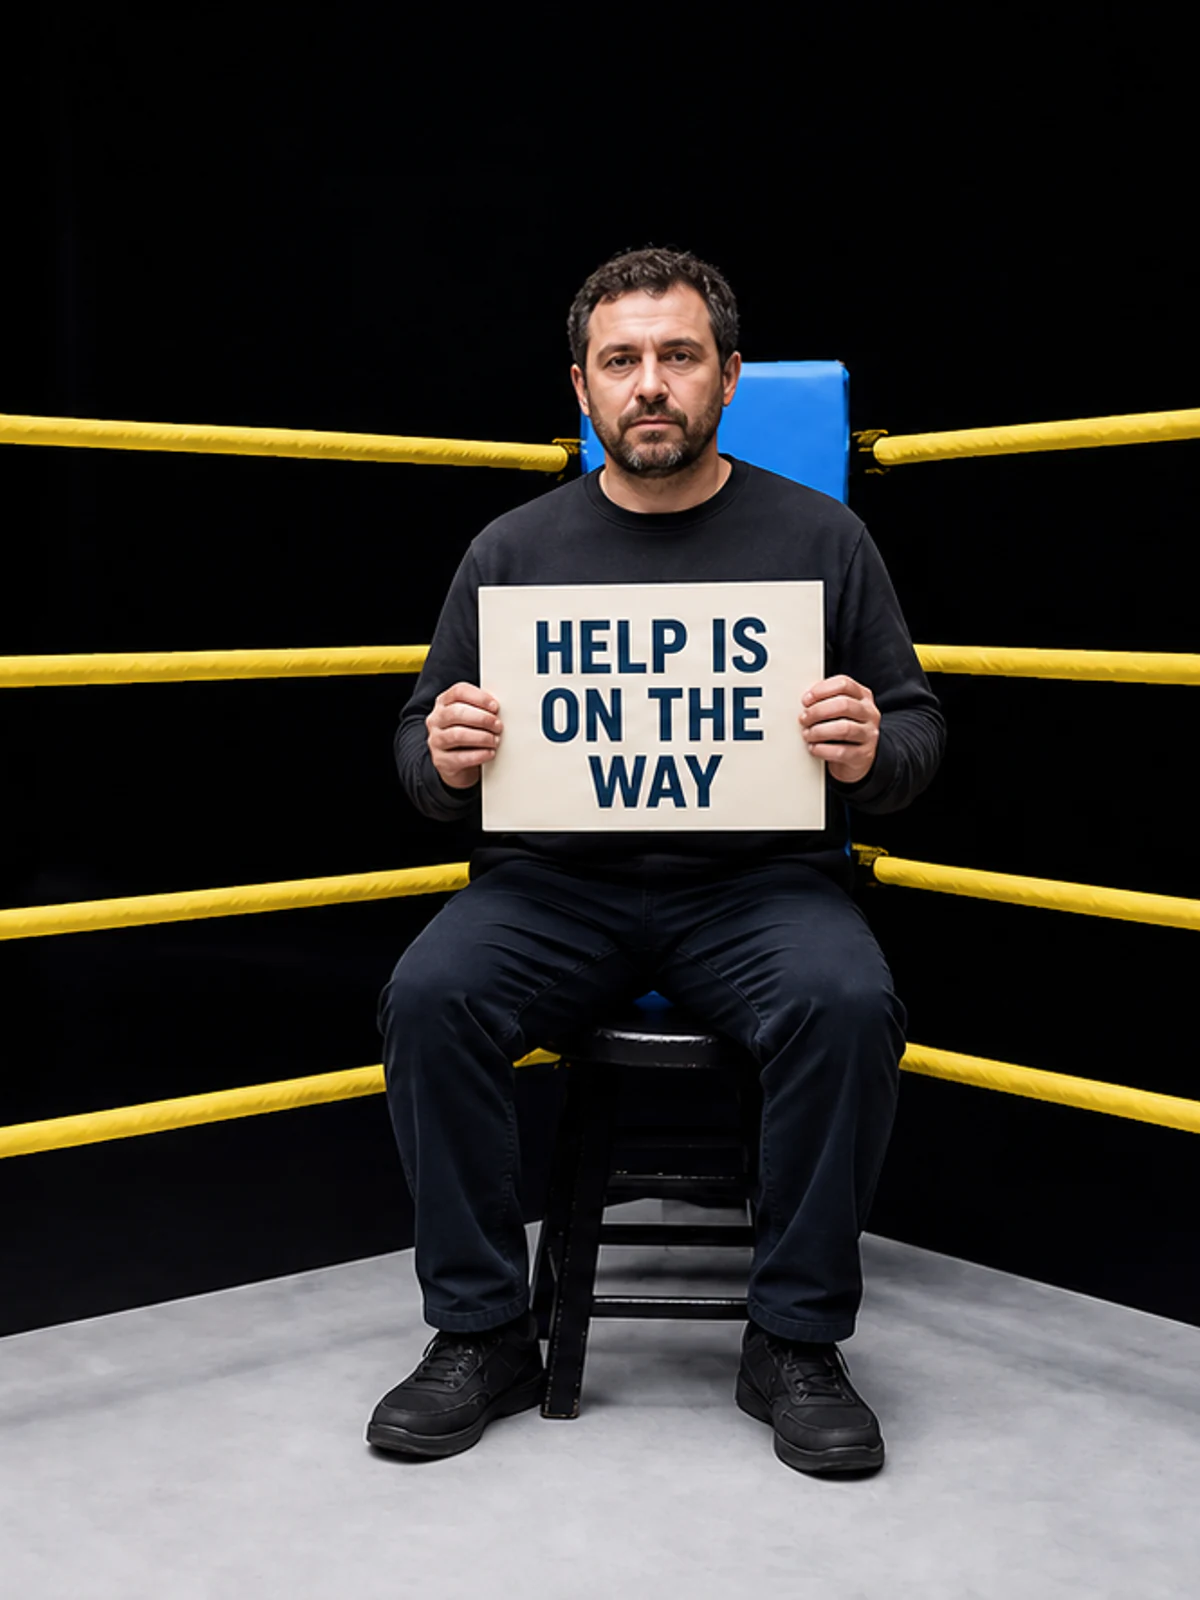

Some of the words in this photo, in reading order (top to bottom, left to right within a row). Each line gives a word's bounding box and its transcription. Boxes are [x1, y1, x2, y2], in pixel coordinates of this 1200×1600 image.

[536, 618, 687, 675] HELP
[712, 616, 768, 674] IS
[541, 687, 623, 743] ON
[647, 686, 764, 742] THE
[588, 754, 723, 809] WAY
